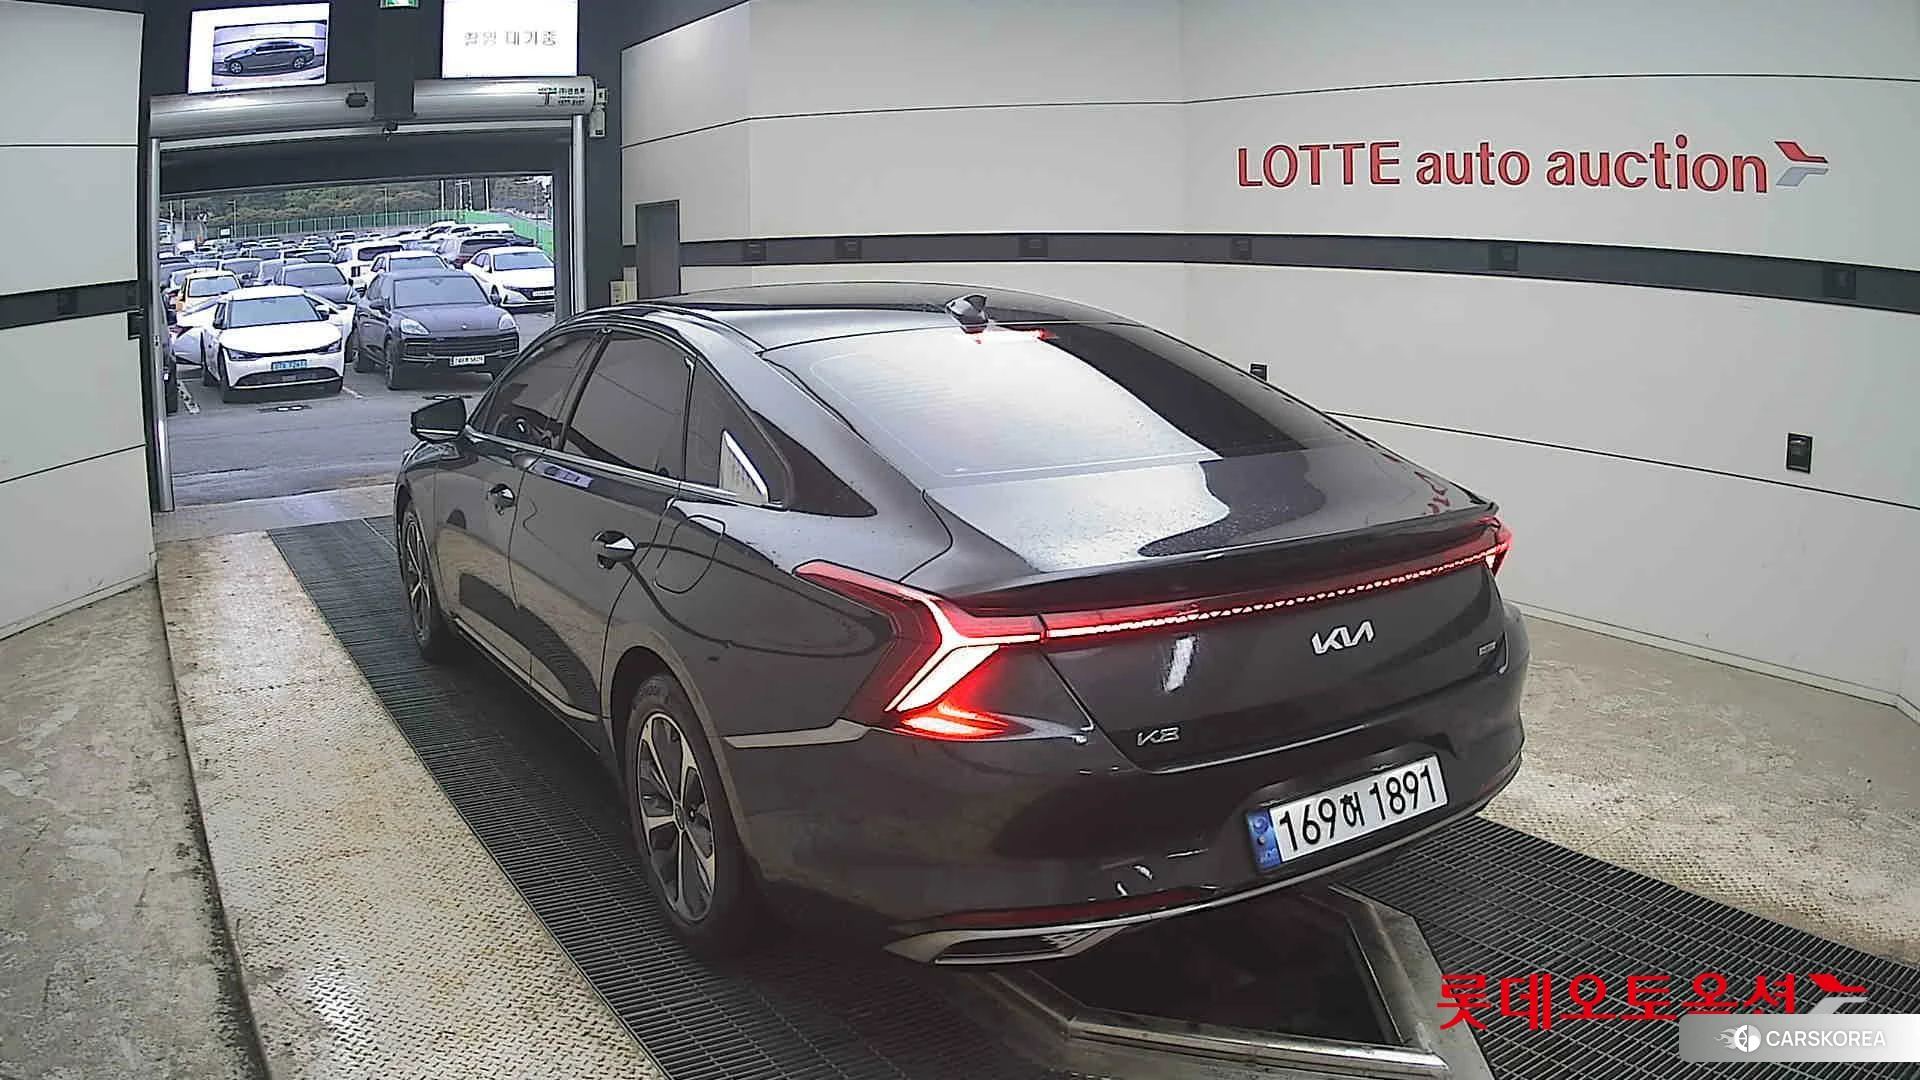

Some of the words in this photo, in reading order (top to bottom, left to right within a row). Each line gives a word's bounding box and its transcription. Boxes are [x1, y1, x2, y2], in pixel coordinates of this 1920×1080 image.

[504, 30, 557, 47] 대기중
[1237, 141, 1400, 188] LOTTE
[1416, 141, 1530, 186] auto
[1546, 134, 1768, 193] auction
[1311, 621, 1374, 654] KIA
[1137, 727, 1180, 746] K8
[1279, 790, 1365, 851] 169허
[1369, 764, 1437, 821] 1891
